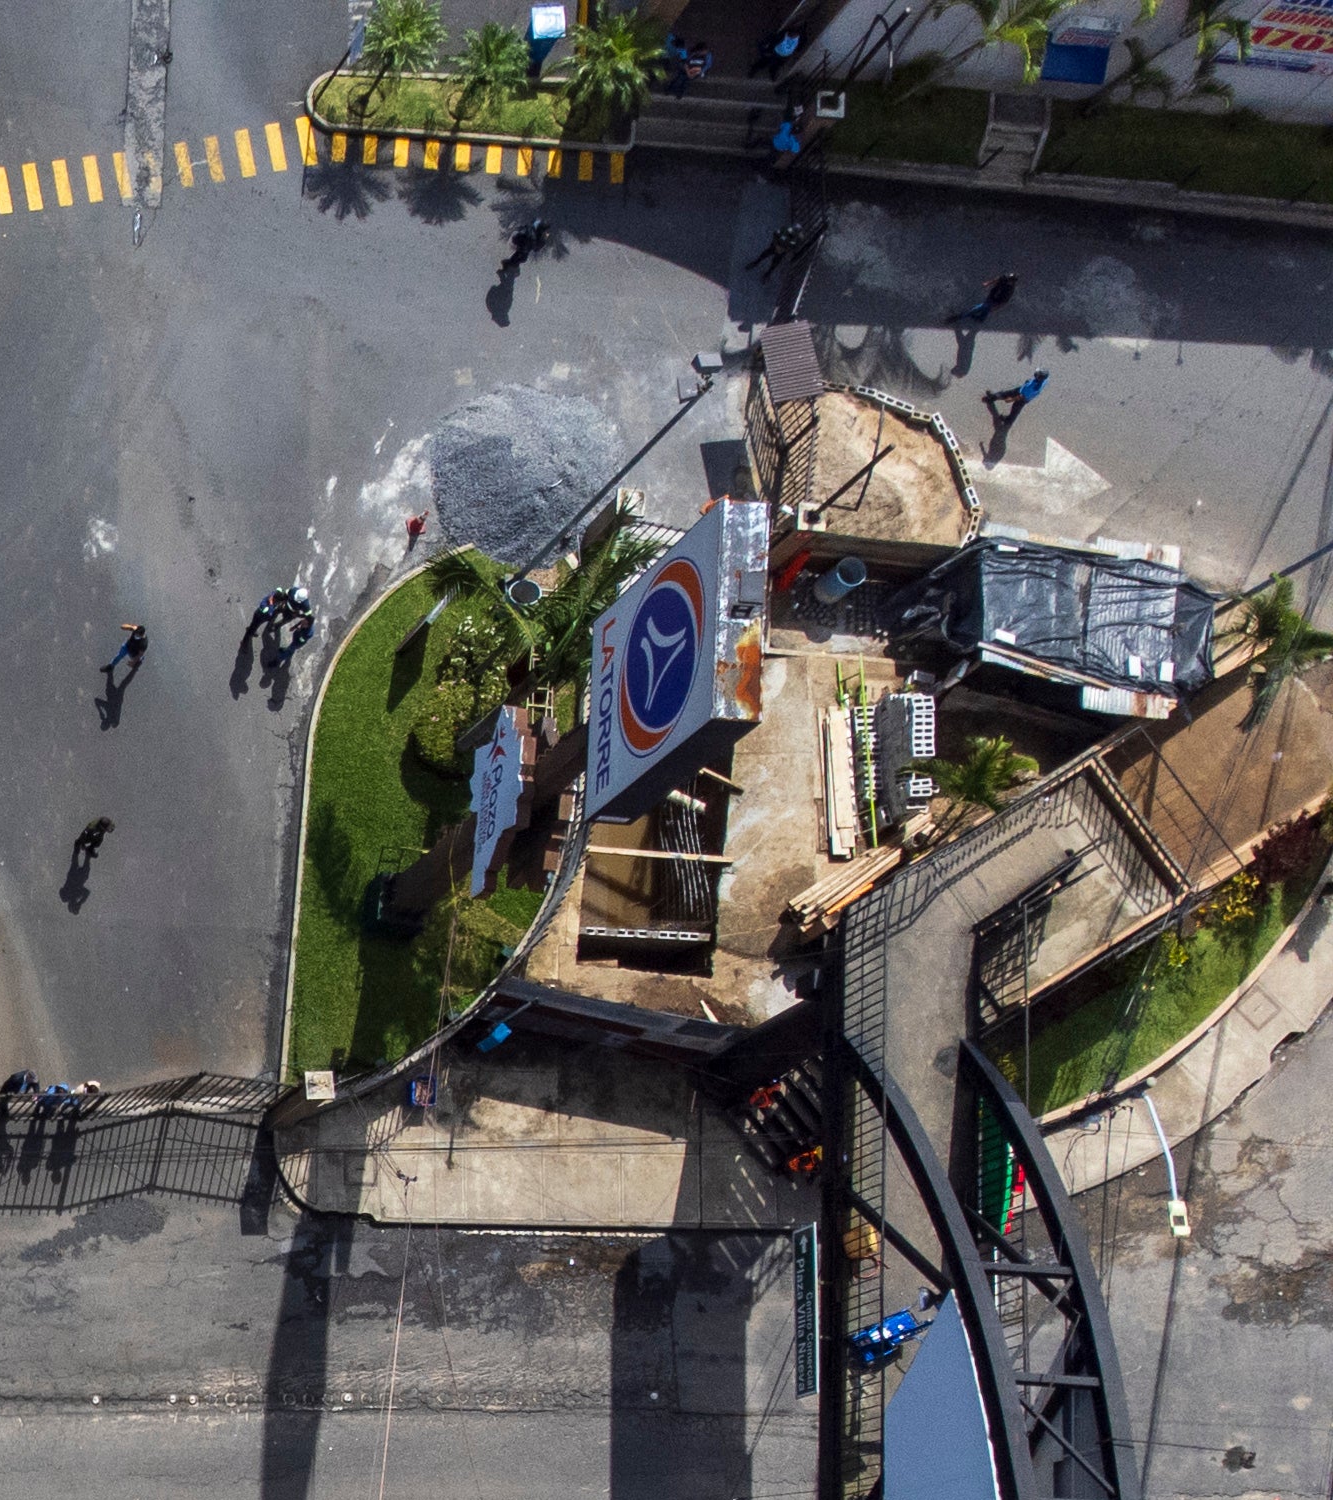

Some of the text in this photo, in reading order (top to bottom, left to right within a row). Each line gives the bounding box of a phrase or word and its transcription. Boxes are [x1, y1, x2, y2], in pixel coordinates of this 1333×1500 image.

[796, 1258, 807, 1392] Plaza Villa Nueva
[805, 1292, 815, 1390] Centro Comercial
